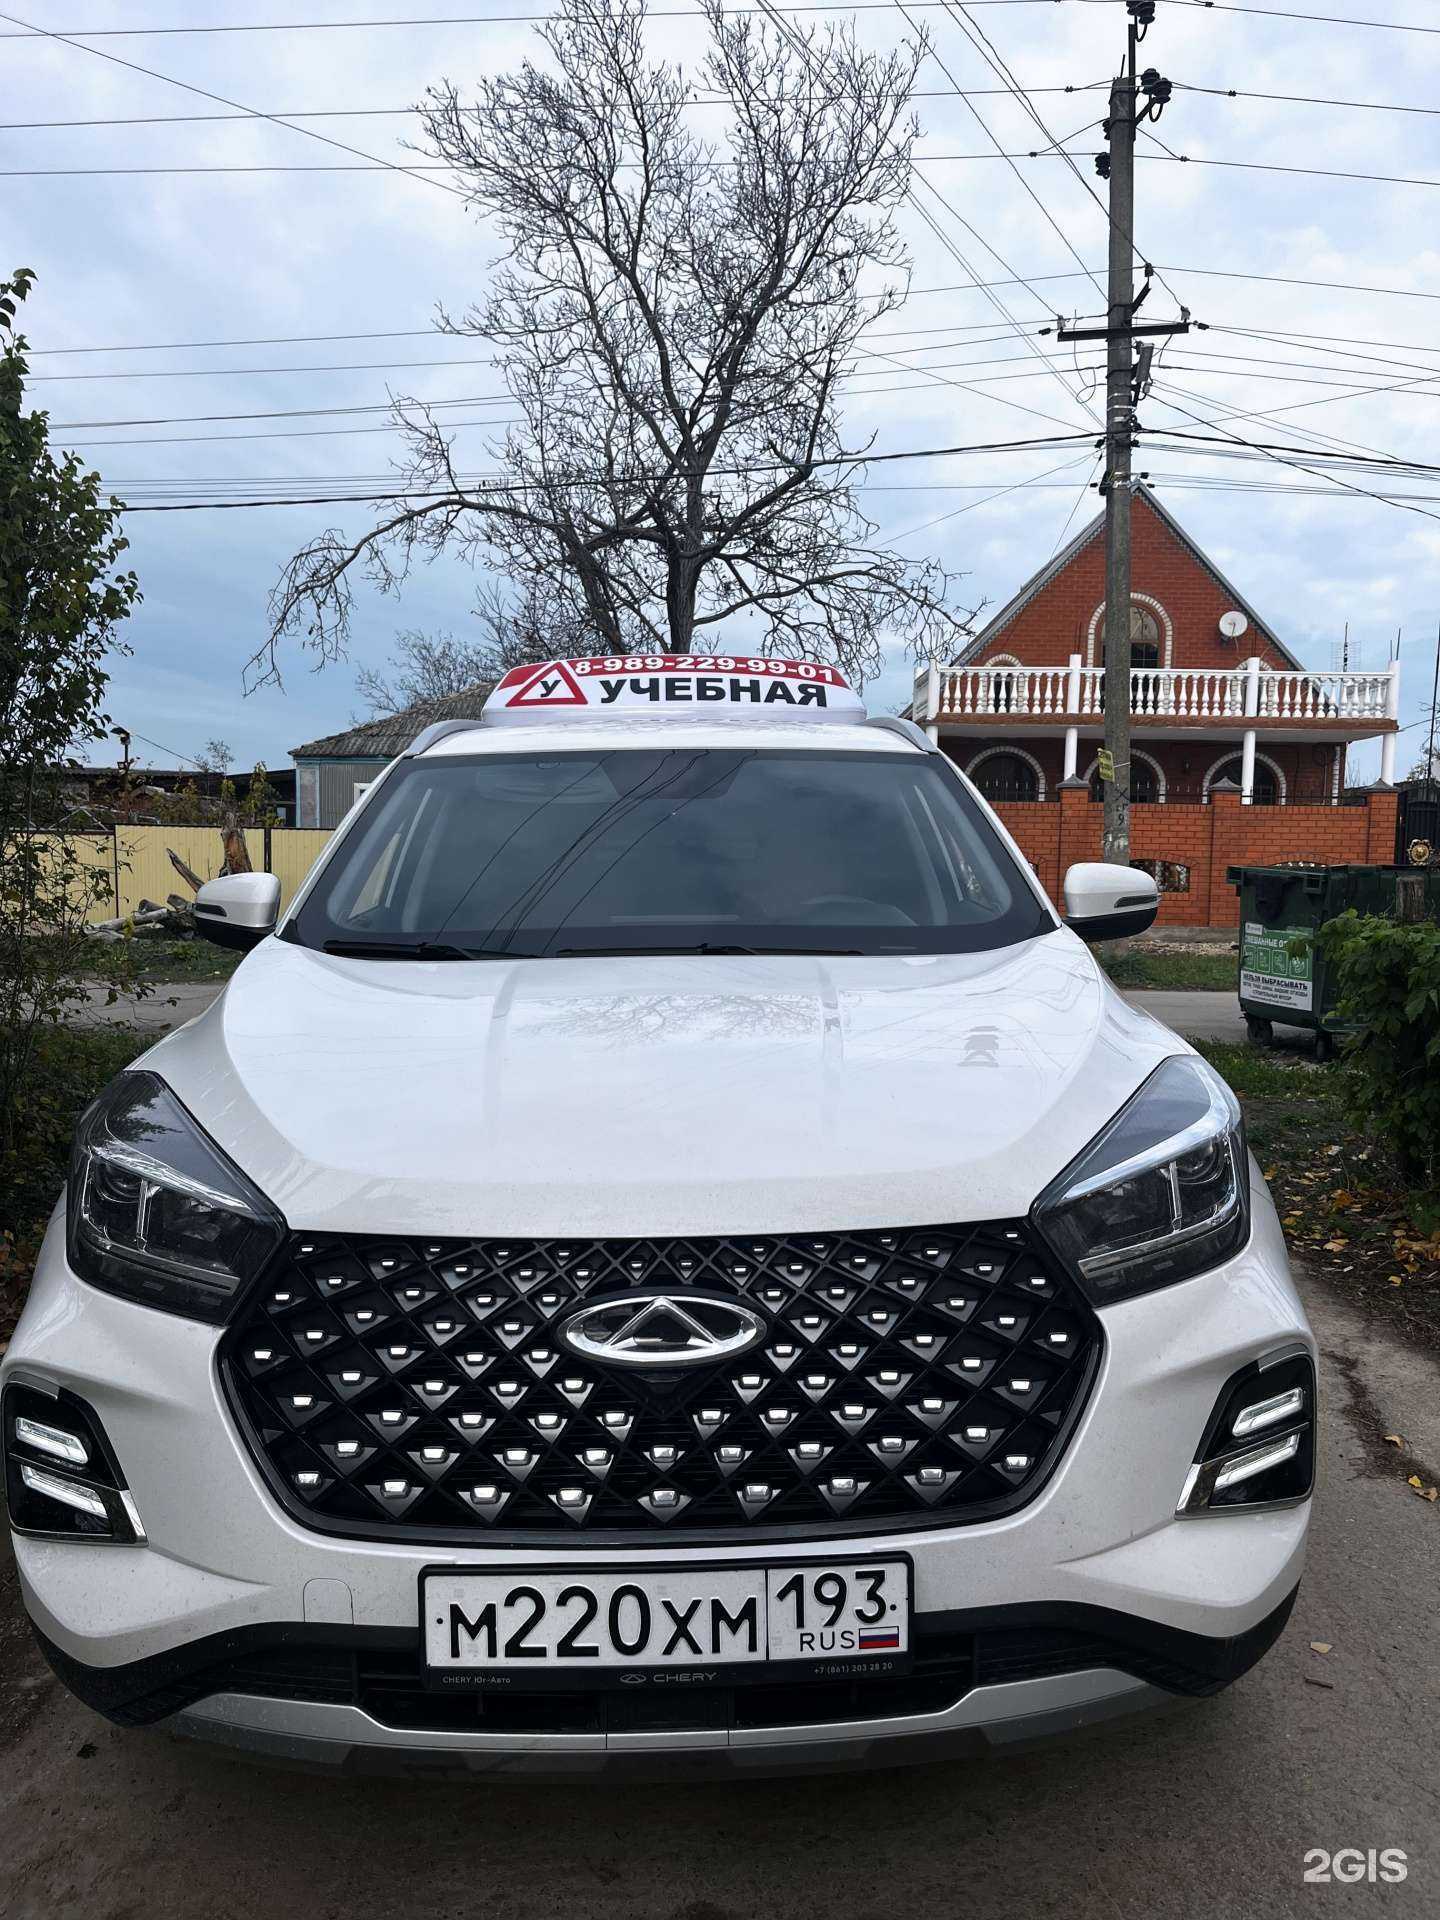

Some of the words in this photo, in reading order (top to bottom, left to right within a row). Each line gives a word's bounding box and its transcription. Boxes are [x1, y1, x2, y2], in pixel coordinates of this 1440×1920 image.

[575, 656, 833, 682] 8-989-229-99-01
[539, 679, 562, 698] У
[600, 677, 828, 708] УЧЕБНАЯ
[776, 1569, 887, 1629] 193
[799, 1630, 856, 1651] RUS
[442, 1675, 472, 1684] CHERY
[653, 1672, 718, 1683] CHERY
